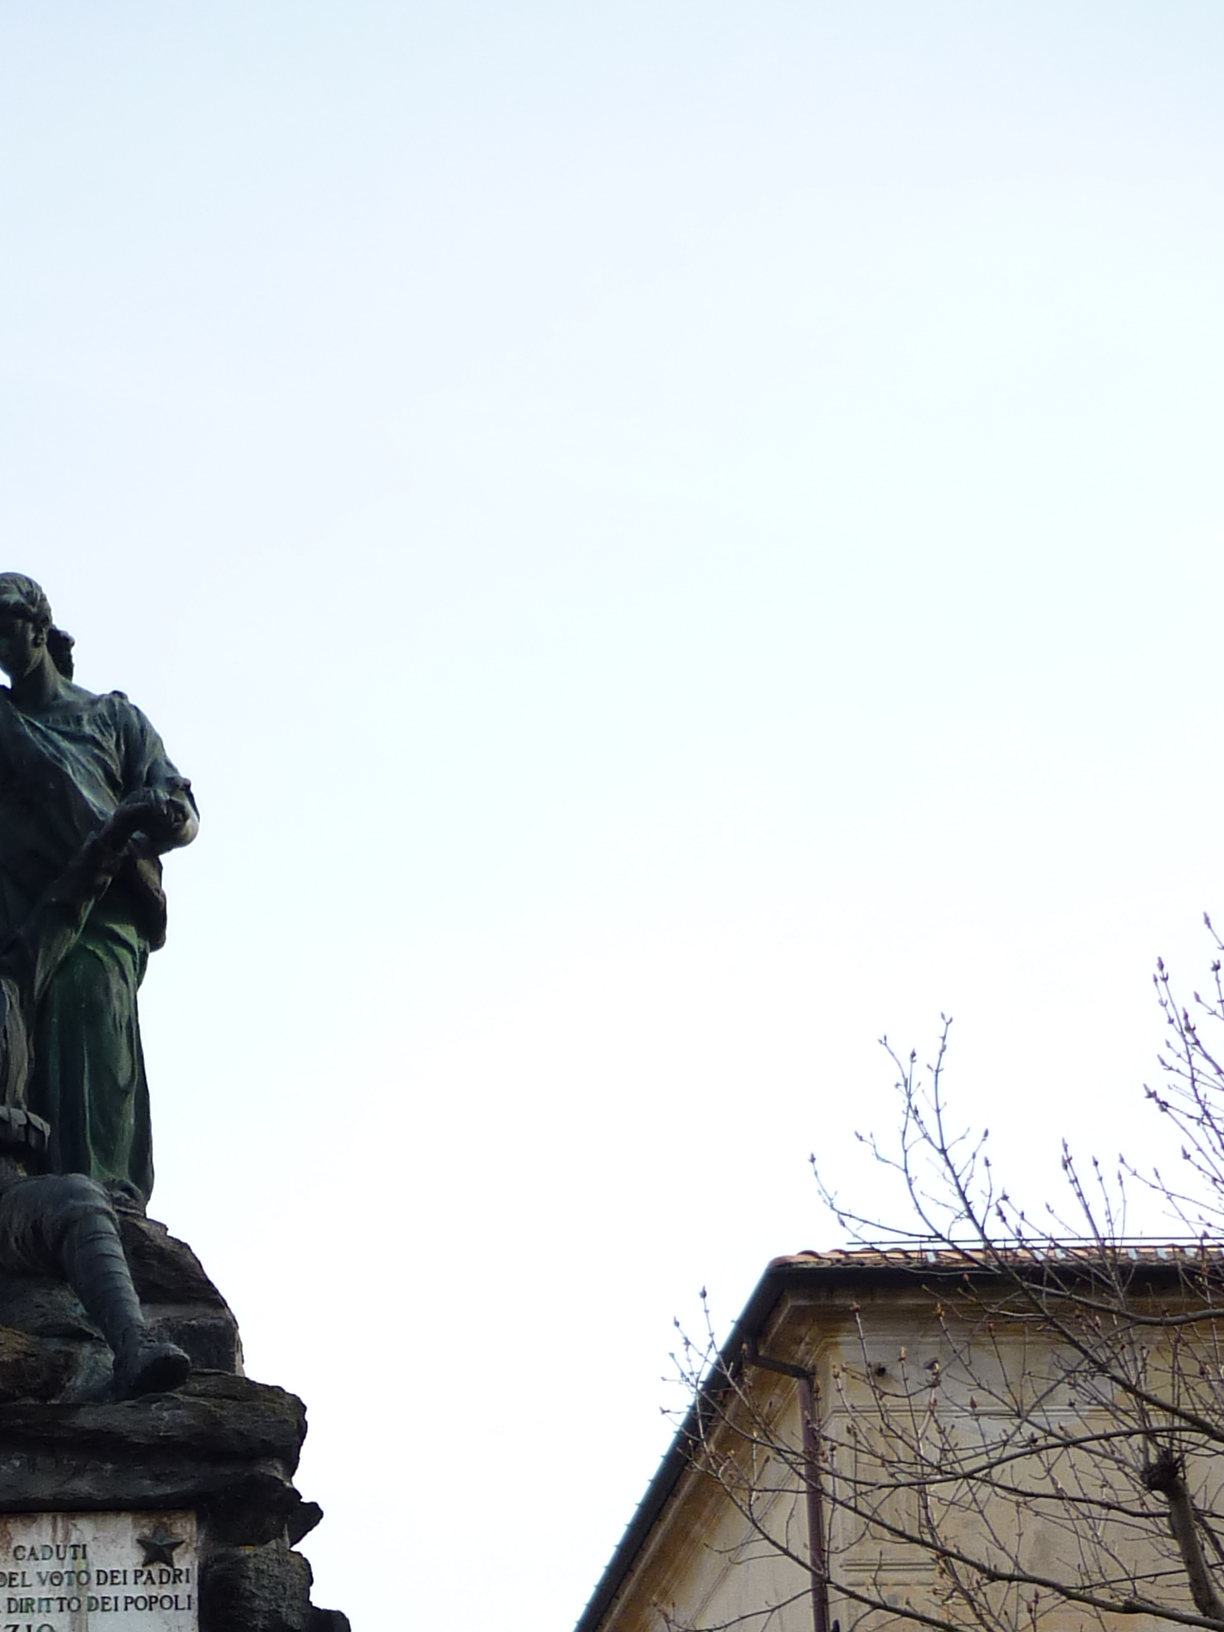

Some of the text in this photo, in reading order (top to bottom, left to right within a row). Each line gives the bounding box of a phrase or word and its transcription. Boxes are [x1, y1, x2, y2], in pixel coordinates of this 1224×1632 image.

[13, 1544, 87, 1561] CADUTI
[37, 1571, 91, 1587] VOTO
[96, 1569, 127, 1586] DEI
[133, 1568, 190, 1585] PADRI
[7, 1597, 81, 1614] DIRITTO
[87, 1596, 119, 1612] DEI
[124, 1595, 192, 1611] POPOLI
